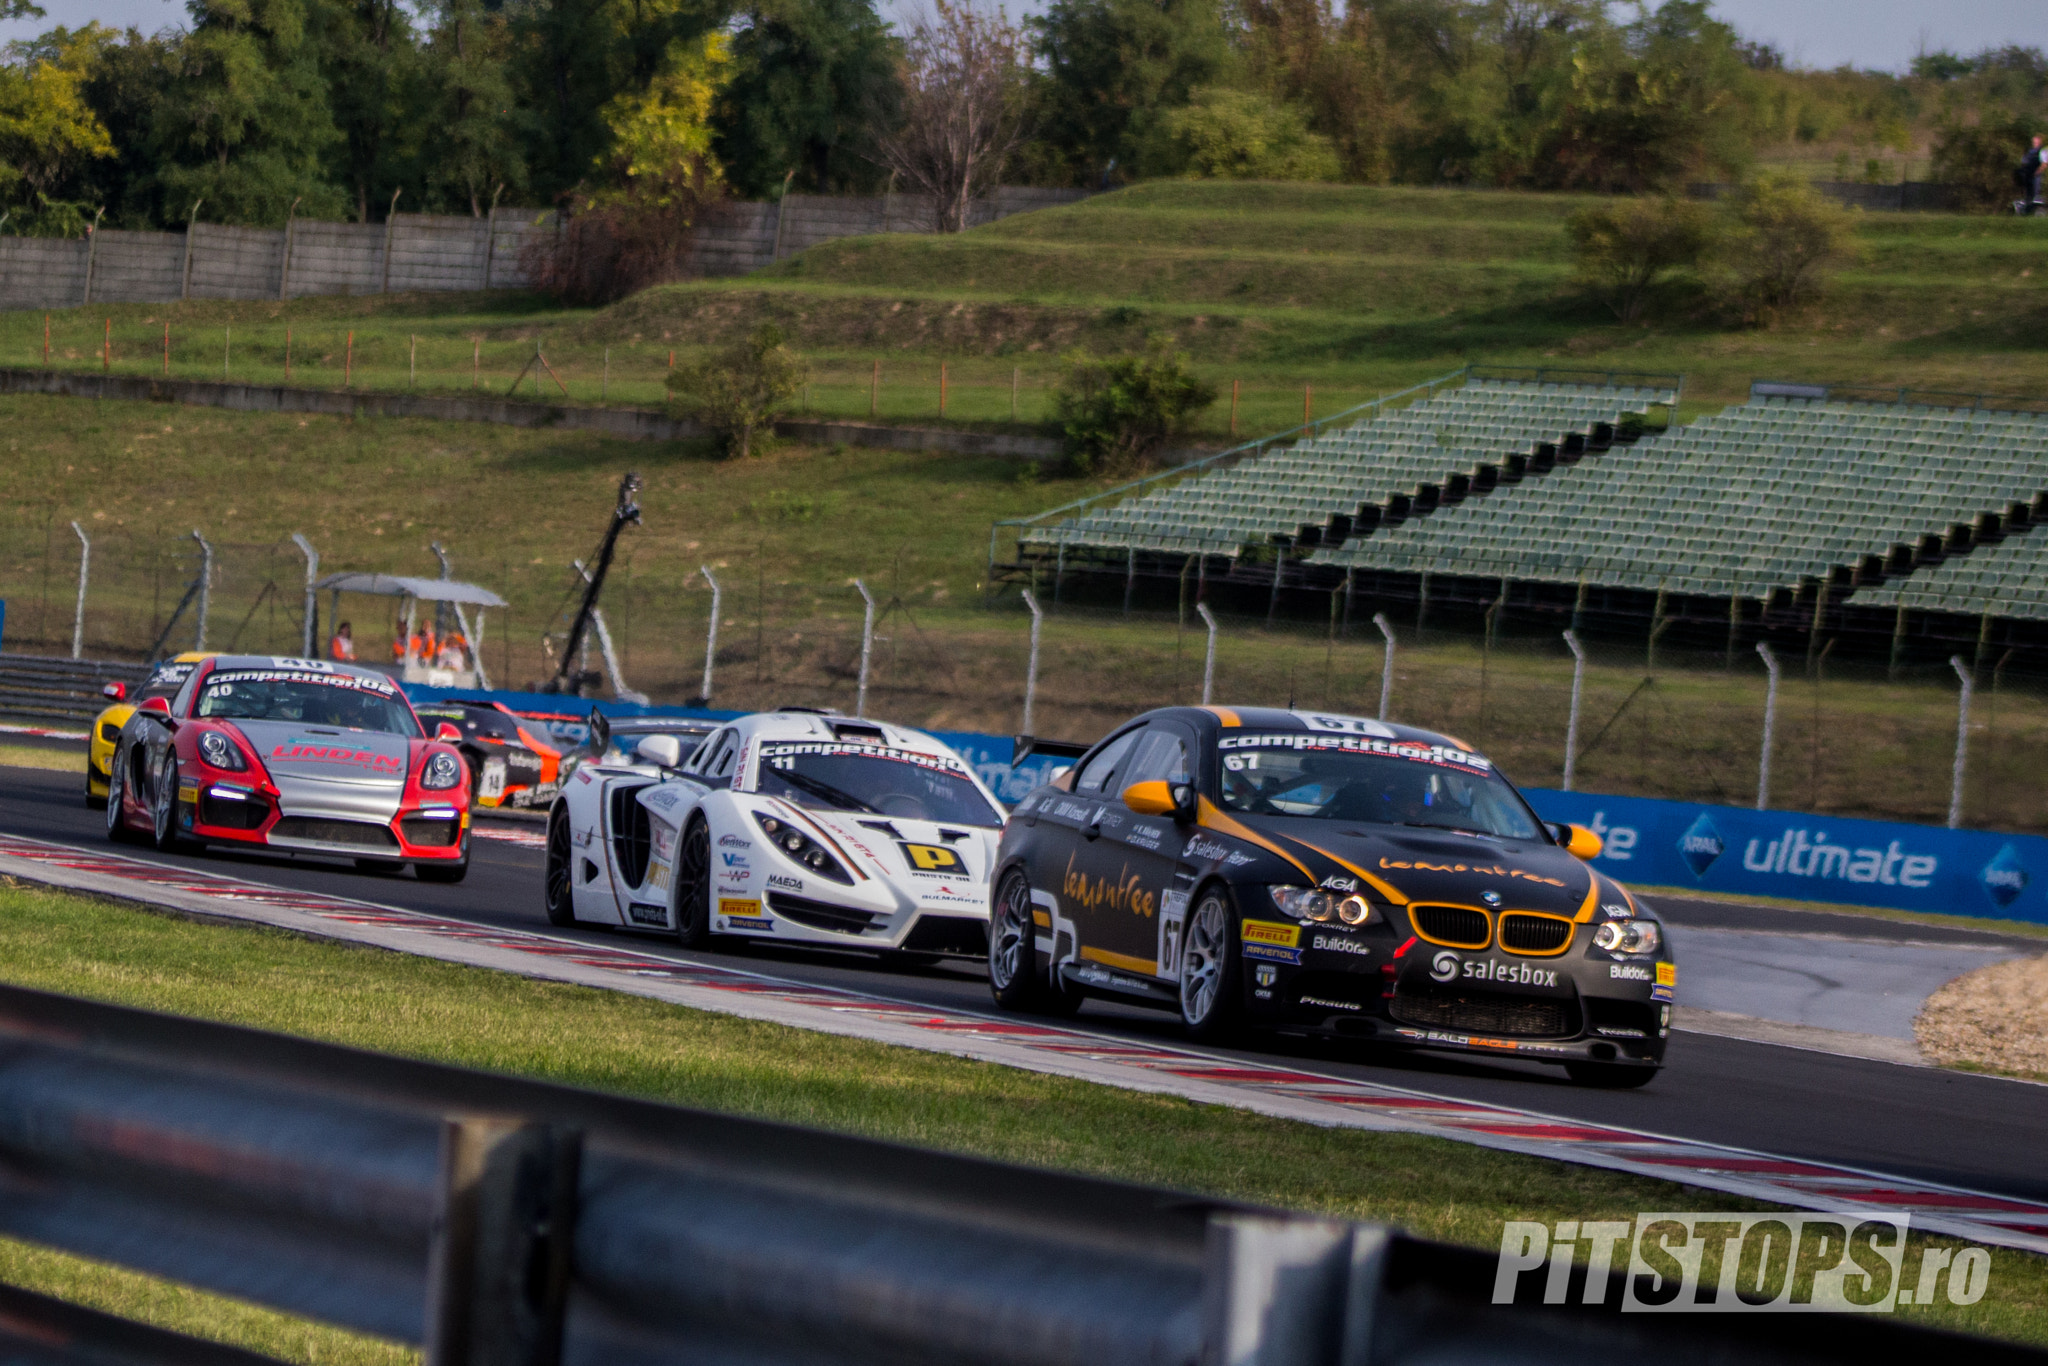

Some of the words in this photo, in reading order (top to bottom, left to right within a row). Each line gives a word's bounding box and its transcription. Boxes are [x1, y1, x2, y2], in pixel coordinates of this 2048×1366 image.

[208, 683, 232, 698] 40
[271, 744, 400, 768] LINDEN
[770, 757, 794, 771] 11
[1223, 752, 1259, 770] 67
[1744, 825, 1938, 889] ultimate
[768, 875, 804, 890] MAEDA
[1319, 875, 1358, 892] AGA
[720, 901, 758, 914] PIRELLI
[1244, 923, 1293, 943] PIRELLI
[1163, 919, 1182, 973] 67
[1246, 945, 1295, 960] RAVENOL
[1462, 958, 1558, 987] salesbox
[1299, 995, 1363, 1011] Proauto
